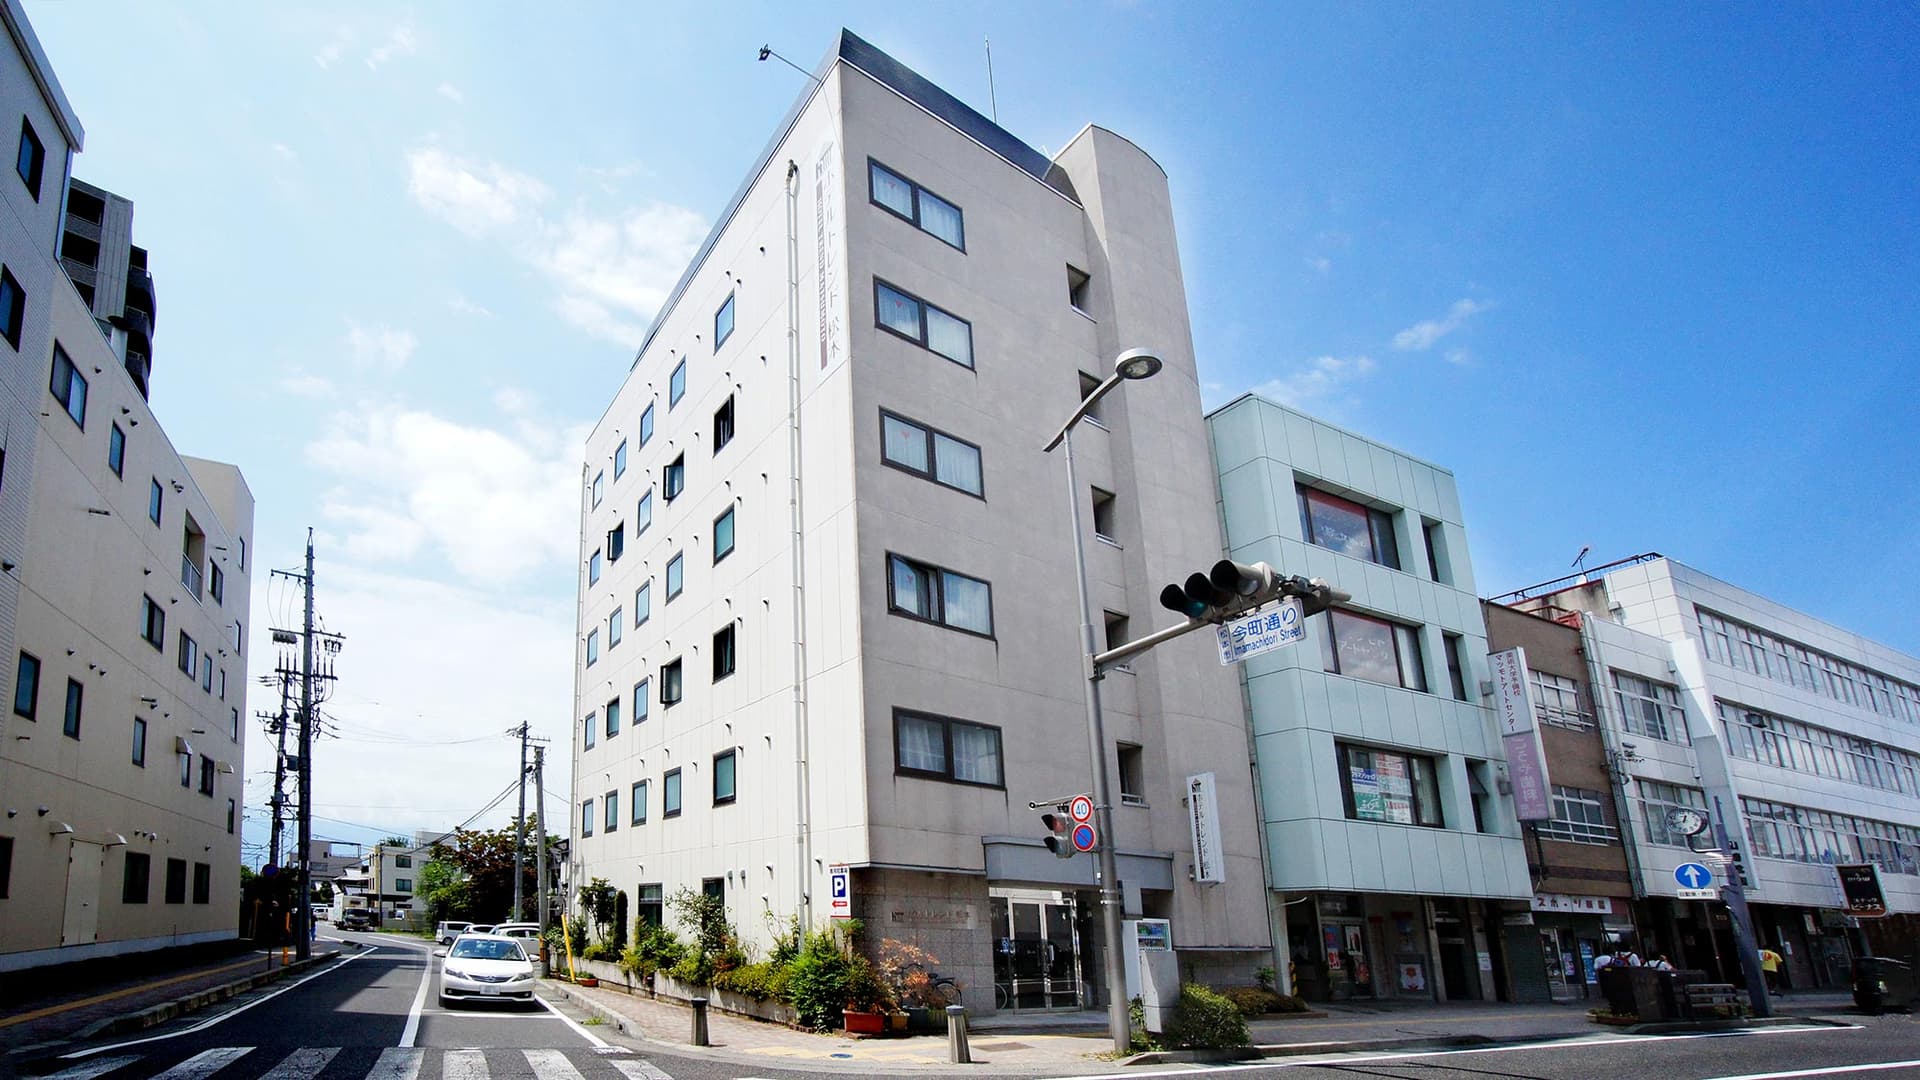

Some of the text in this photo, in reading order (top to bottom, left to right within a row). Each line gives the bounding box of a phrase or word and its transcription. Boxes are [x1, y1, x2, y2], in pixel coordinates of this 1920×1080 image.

[1231, 607, 1297, 643] 今町通り
[1233, 625, 1302, 656] Imamachidori Street
[1495, 654, 1516, 732] マツモトアートセンター
[1075, 803, 1088, 815] 40
[834, 877, 844, 896] P
[1850, 903, 1884, 911] ビーナス
